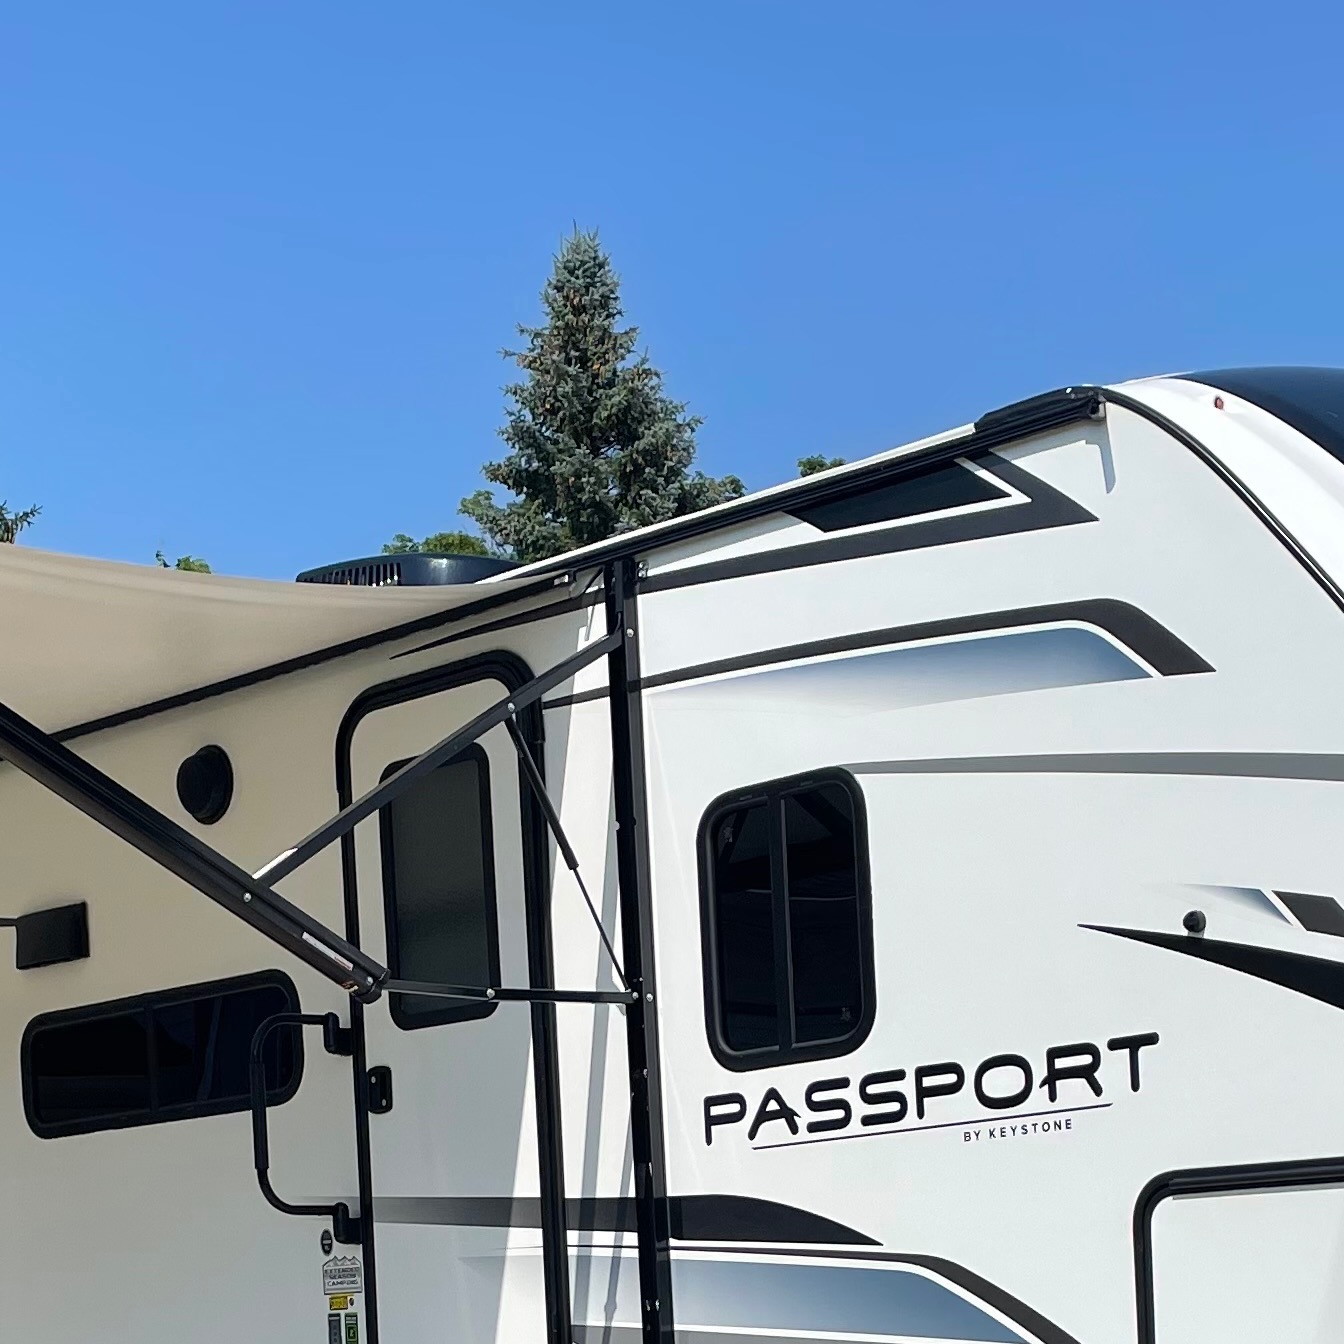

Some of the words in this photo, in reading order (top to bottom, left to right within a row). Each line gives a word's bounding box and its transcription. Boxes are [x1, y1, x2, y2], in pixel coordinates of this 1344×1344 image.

[703, 1031, 1160, 1147] PASSPORT
[963, 1130, 982, 1142] BY
[988, 1118, 1072, 1139] KEYSTONE
